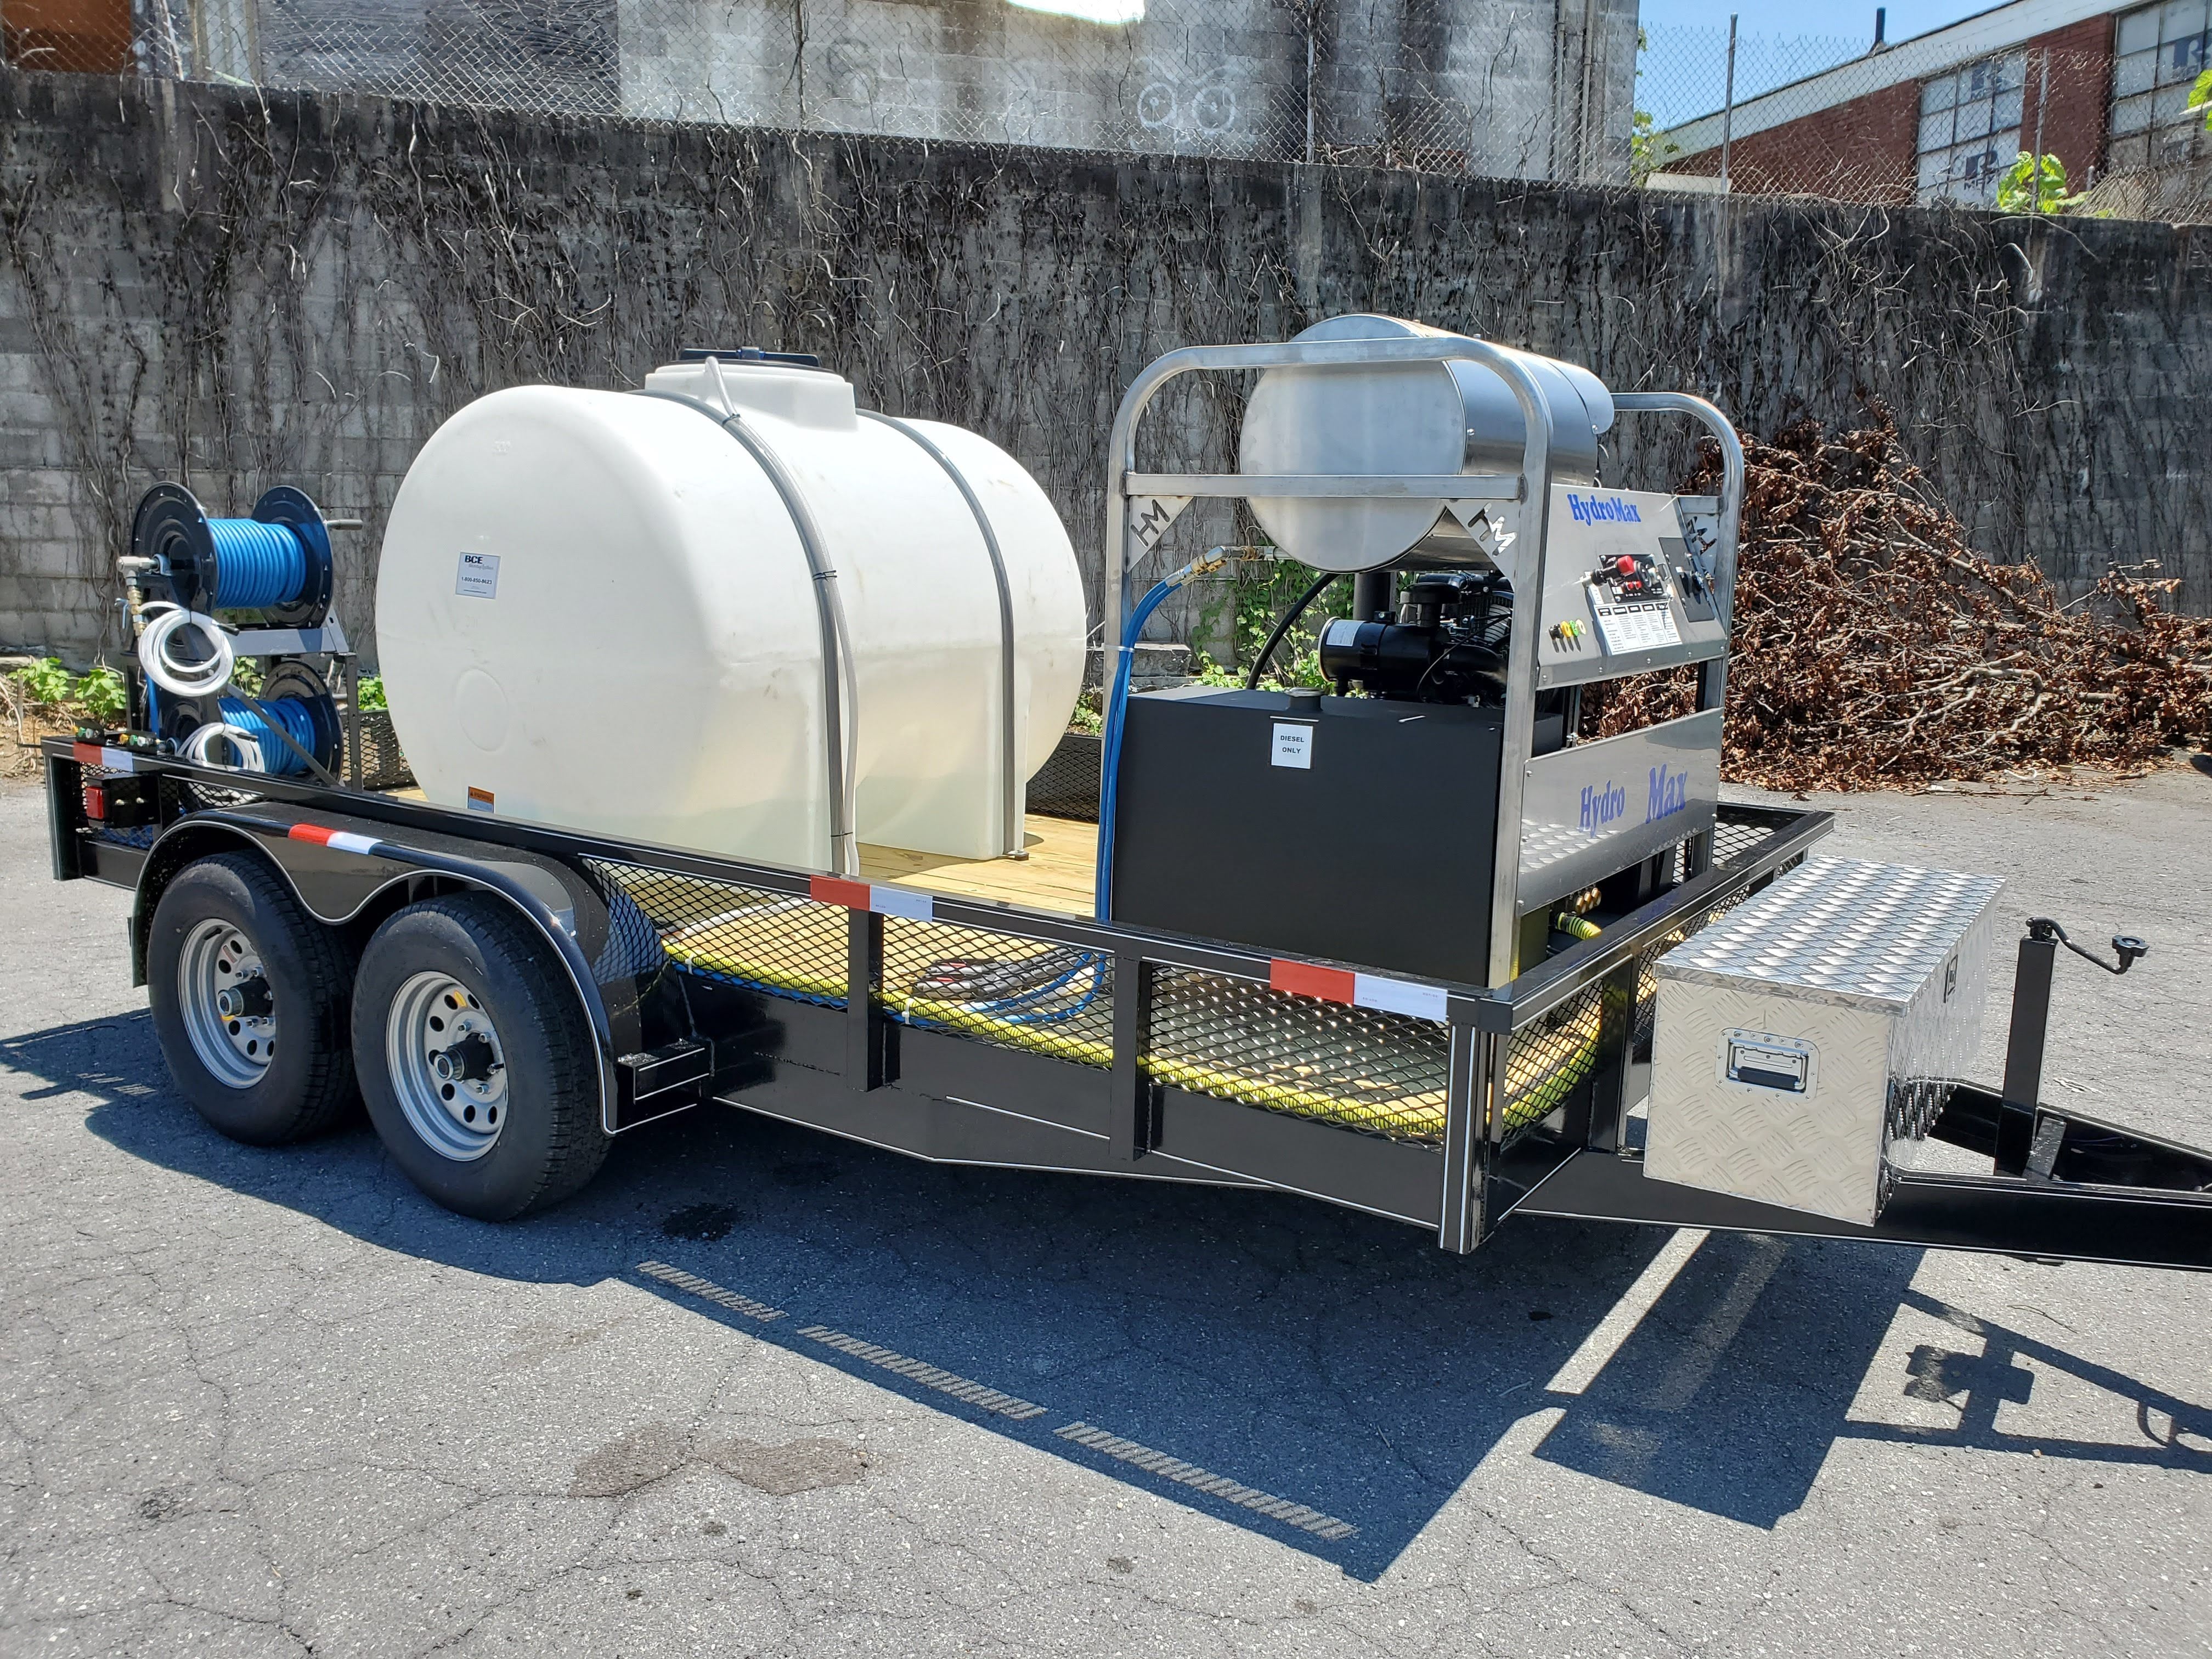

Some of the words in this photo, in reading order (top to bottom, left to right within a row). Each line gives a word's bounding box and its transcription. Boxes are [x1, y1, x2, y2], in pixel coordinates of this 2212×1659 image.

[1130, 499, 1170, 548] HM
[1467, 503, 1517, 557] HM
[1567, 494, 1641, 527] HydroMax
[465, 555, 483, 564] BCE
[1578, 780, 1625, 838] Hydro
[1646, 763, 1688, 824] Max
